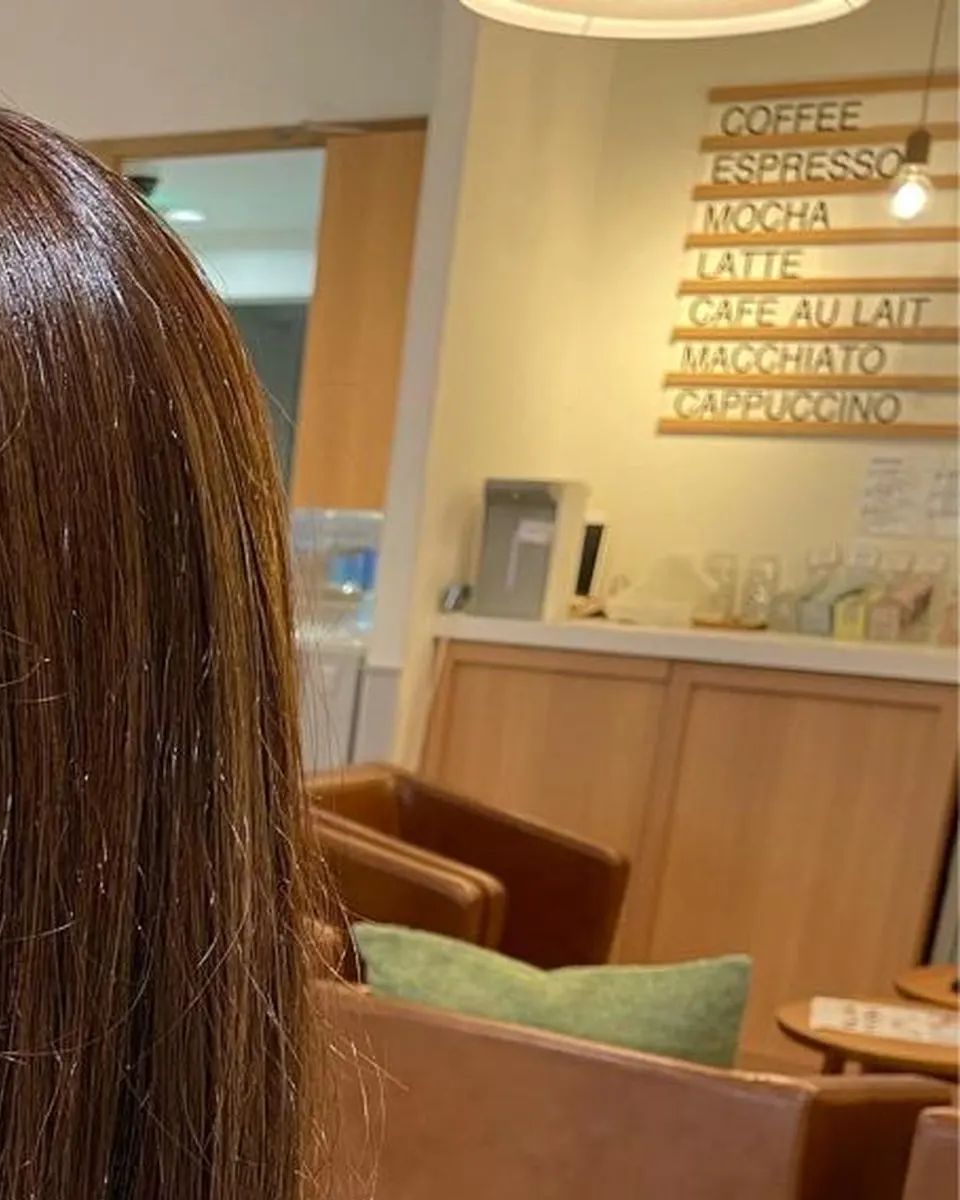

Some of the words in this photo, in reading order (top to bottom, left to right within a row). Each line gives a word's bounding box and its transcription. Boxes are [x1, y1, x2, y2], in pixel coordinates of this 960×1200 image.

[721, 101, 862, 137] COFFEE
[710, 147, 905, 184] ESPRESSO
[703, 201, 830, 233] MOCHA
[696, 250, 804, 280] LATTE
[688, 298, 779, 327] CAFE
[790, 298, 841, 327] AU
[852, 298, 932, 328] LAIT
[680, 344, 888, 375] MACCHIATO
[673, 390, 903, 425] CAPPUCCINO
